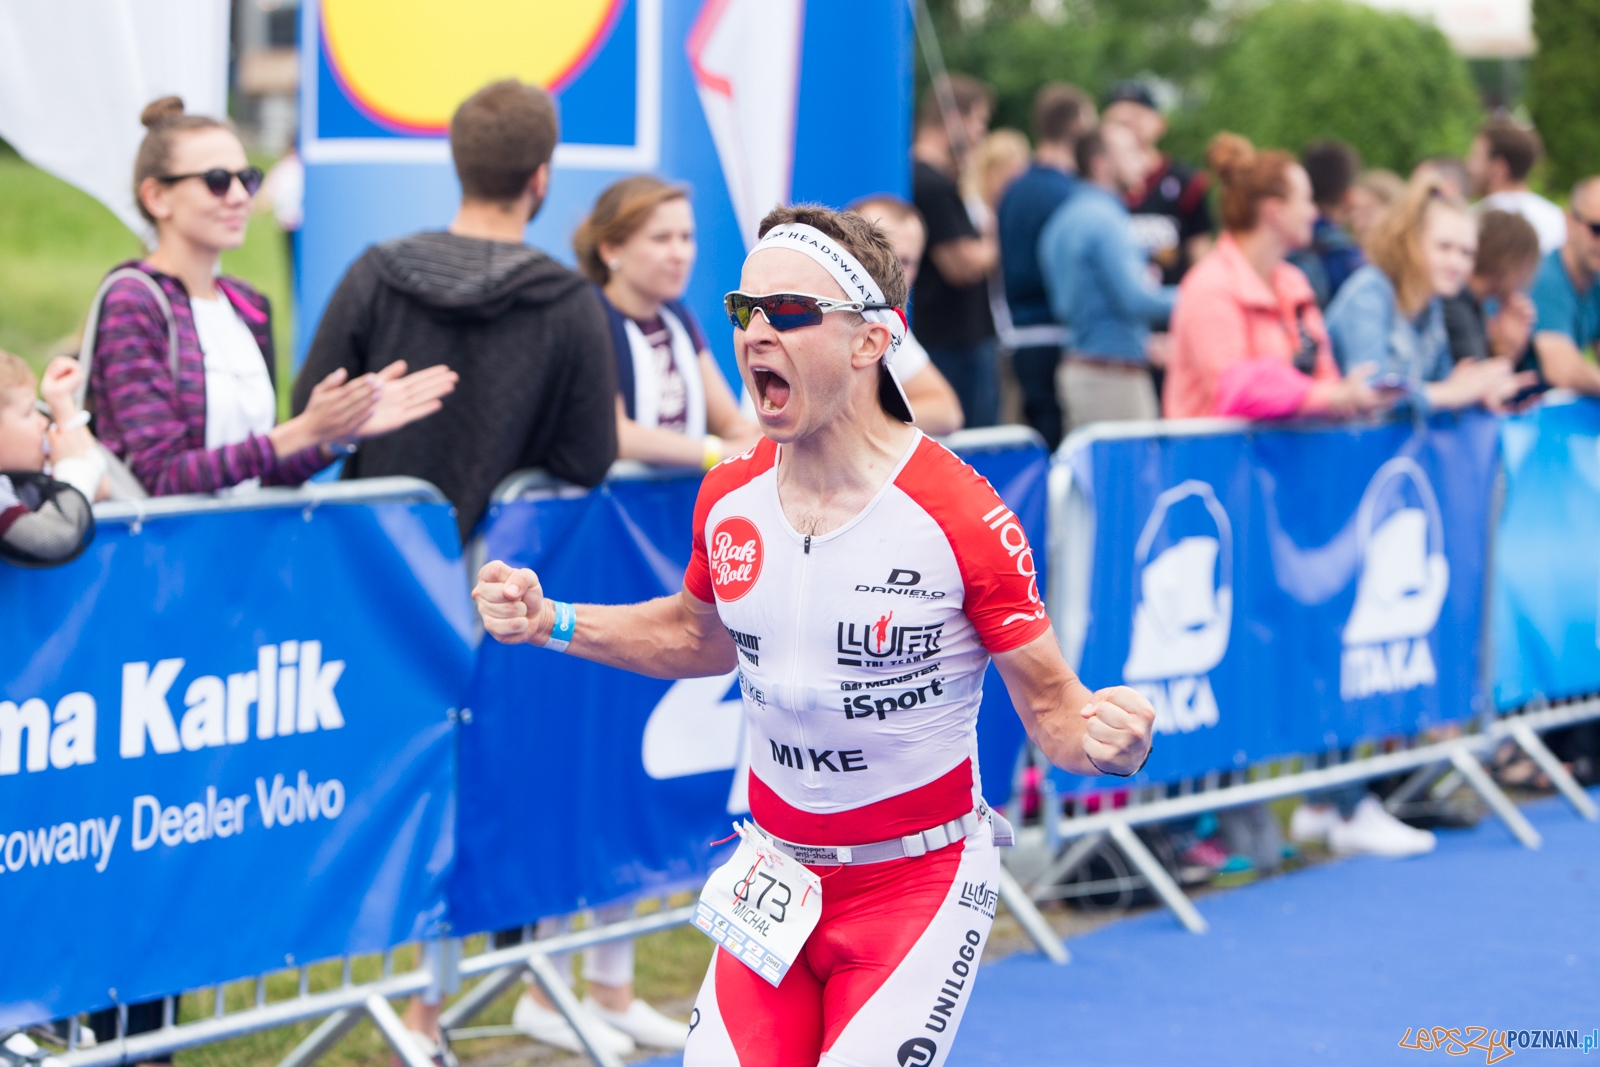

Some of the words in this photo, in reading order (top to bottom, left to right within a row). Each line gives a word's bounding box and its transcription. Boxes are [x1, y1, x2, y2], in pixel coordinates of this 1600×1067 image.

[788, 231, 876, 303] HEADSWEAT
[713, 531, 757, 563] Rak
[716, 562, 753, 586] Roll
[854, 584, 946, 598] DANIELO
[864, 660, 884, 668] TRI
[890, 655, 924, 666] TEAM
[866, 664, 940, 689] MONSTER
[119, 639, 346, 759] Karlik
[843, 677, 945, 721] iSport
[769, 738, 868, 773] MIKE
[131, 785, 251, 852] Dealer
[255, 769, 346, 830] Volvo
[795, 850, 838, 860] anti-shock
[733, 865, 792, 923] 873
[732, 902, 771, 937] MICHAŁ
[925, 929, 981, 1034] UNILOGO
